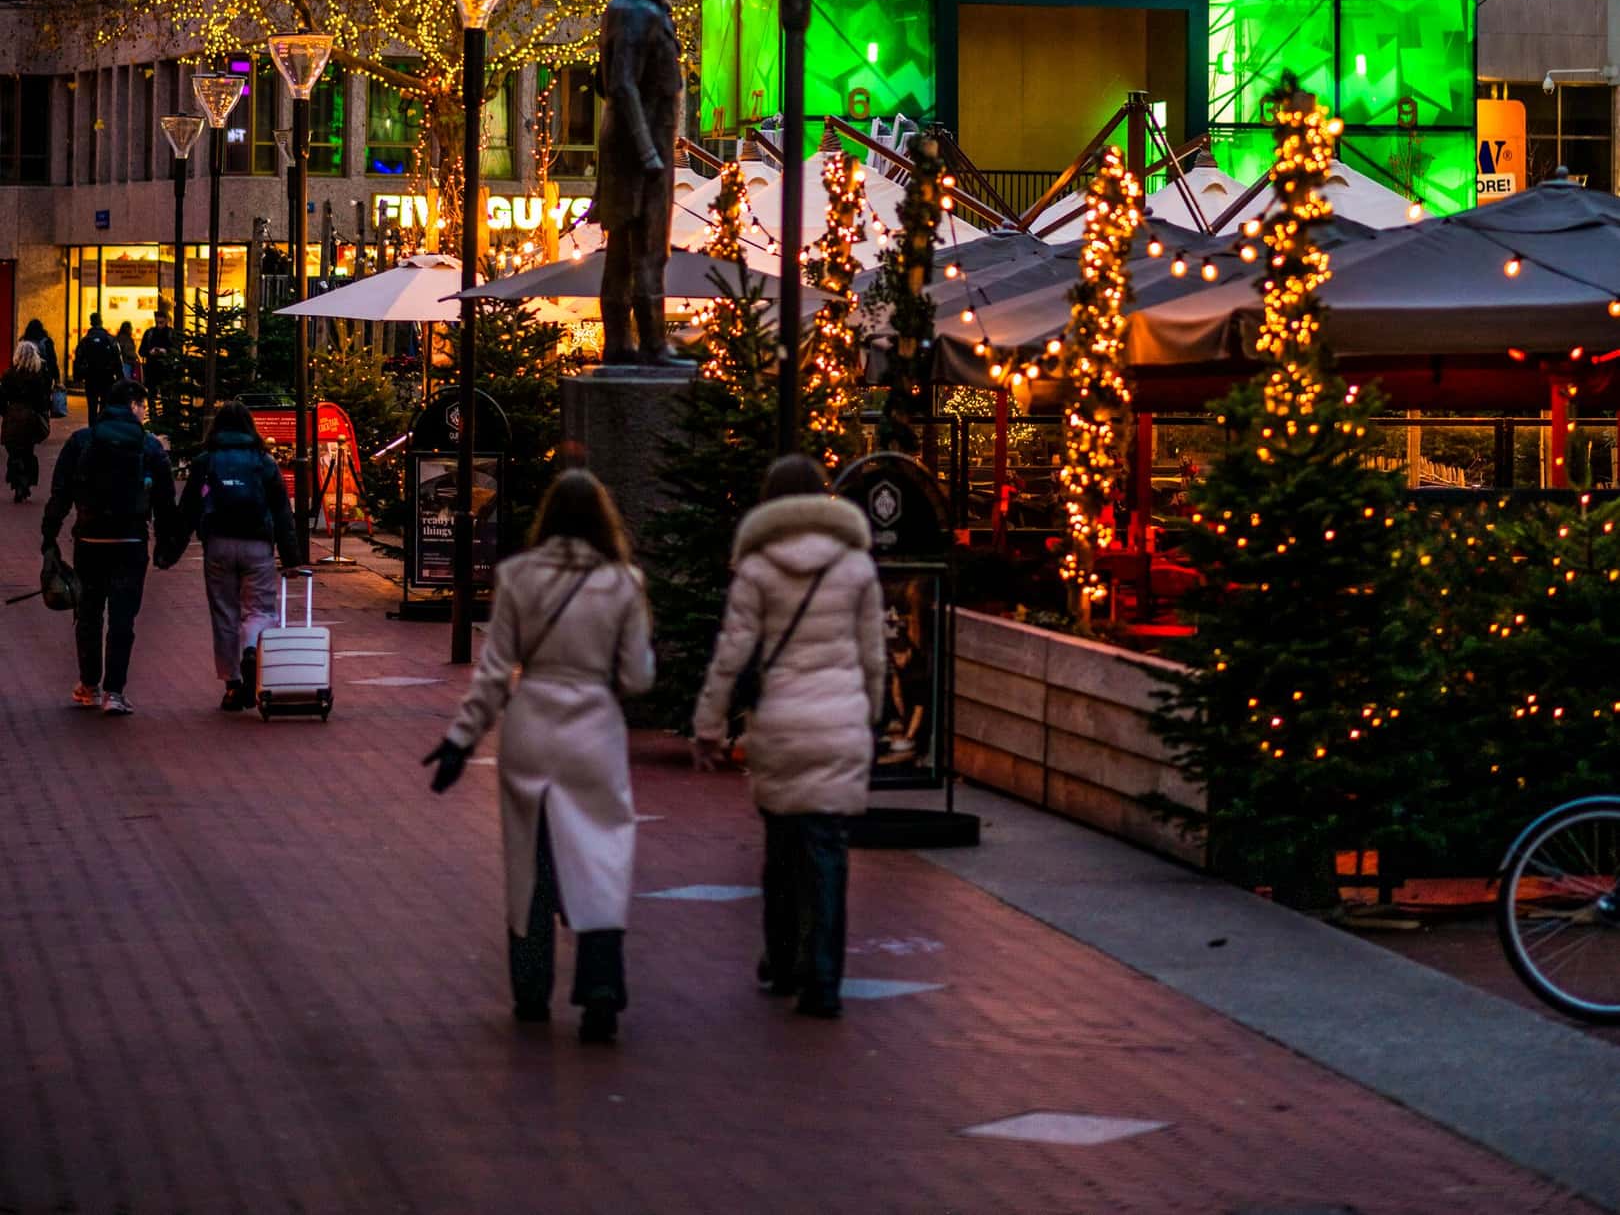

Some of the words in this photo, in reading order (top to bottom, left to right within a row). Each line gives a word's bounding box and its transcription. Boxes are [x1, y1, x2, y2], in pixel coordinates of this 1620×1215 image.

[847, 88, 870, 119] 6
[1397, 97, 1417, 128] 9
[374, 194, 443, 229] FIV
[487, 196, 592, 230] GUYS
